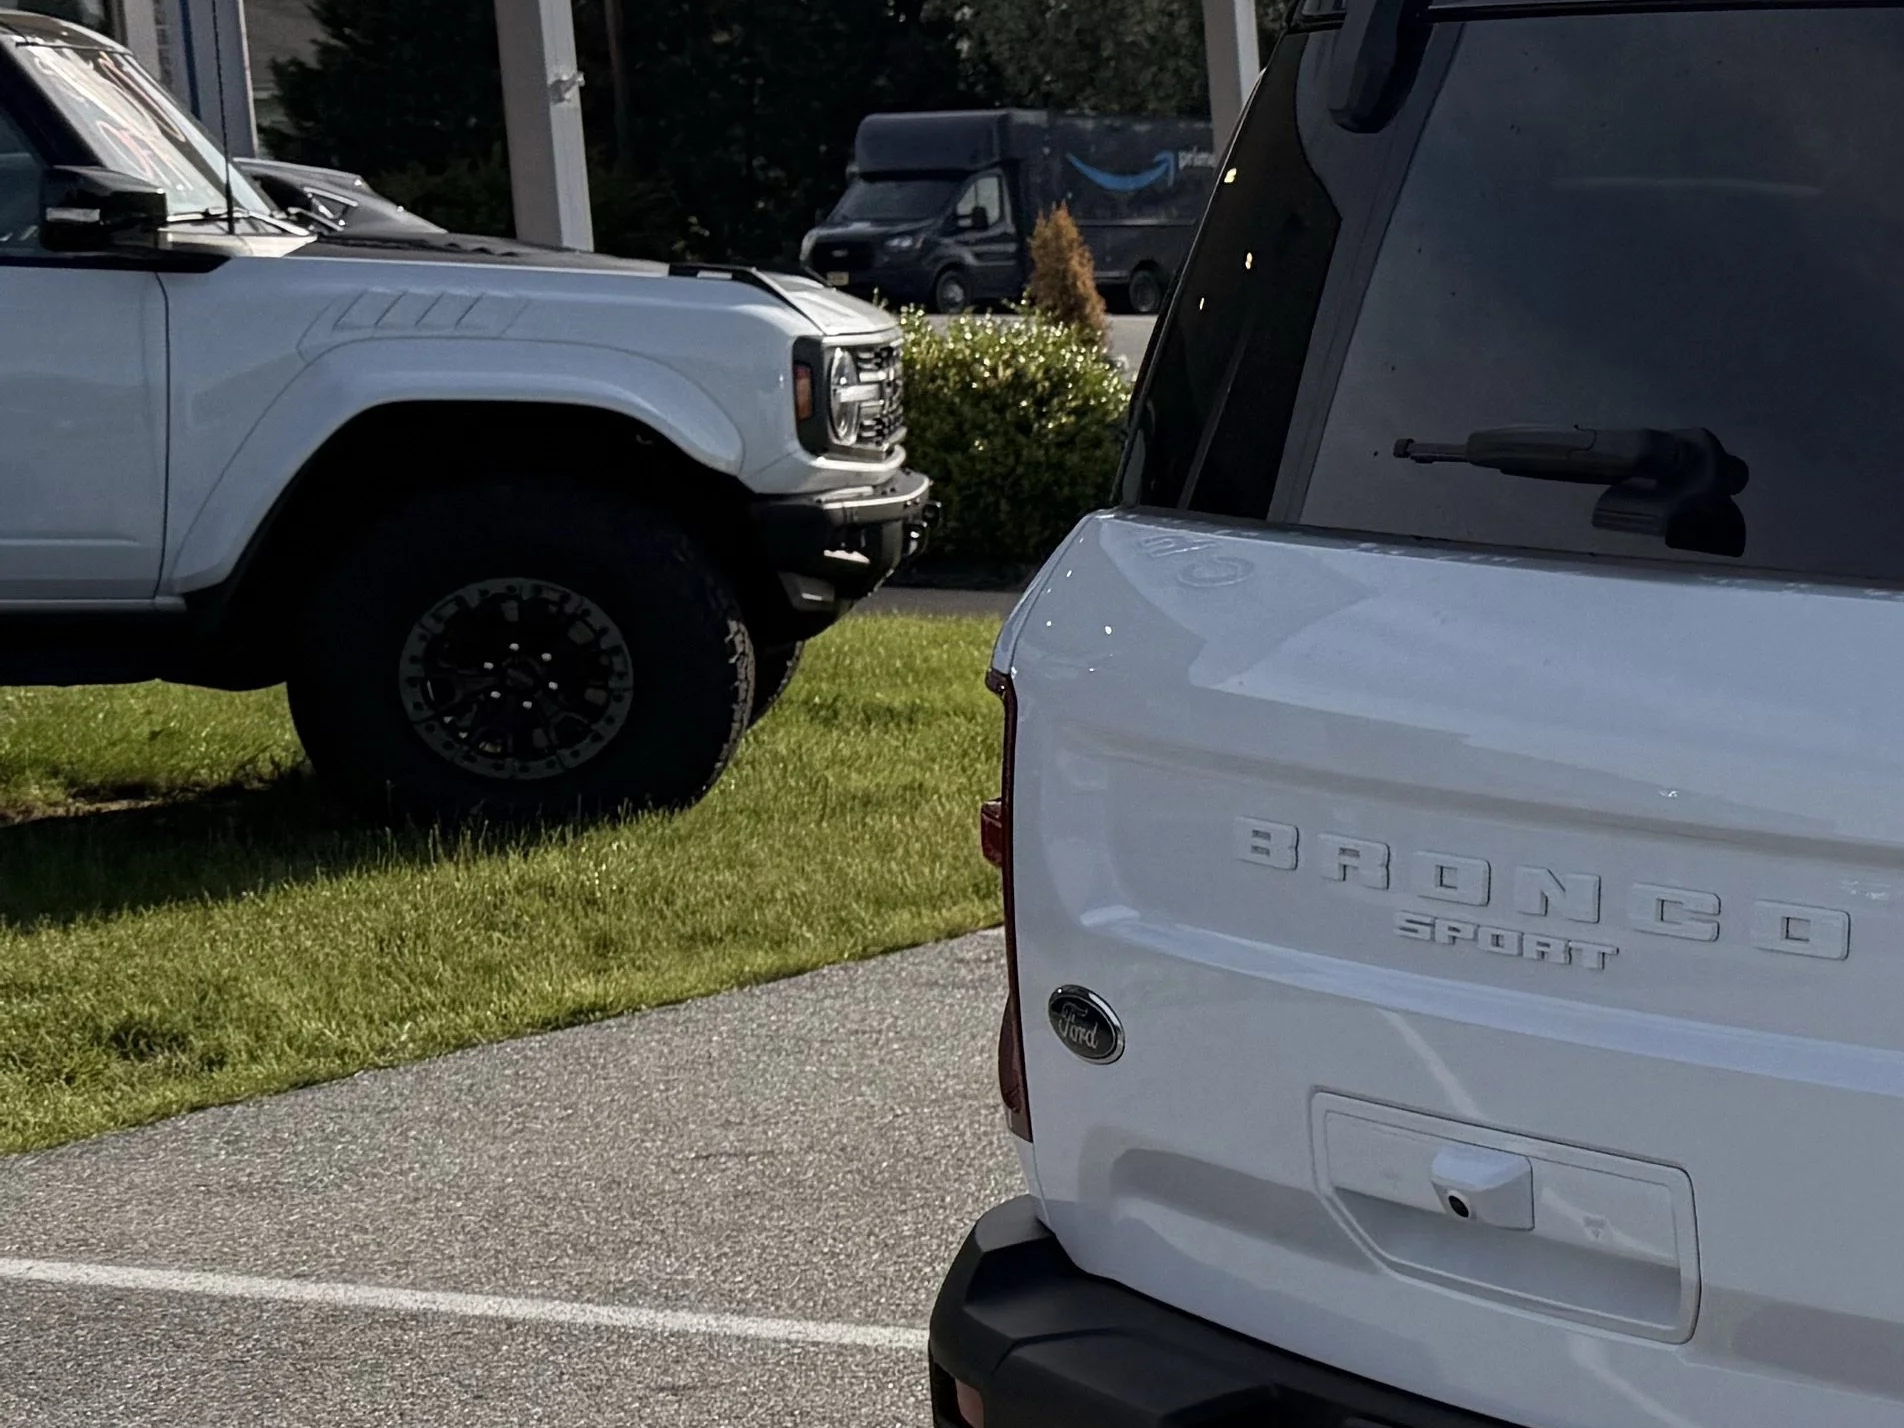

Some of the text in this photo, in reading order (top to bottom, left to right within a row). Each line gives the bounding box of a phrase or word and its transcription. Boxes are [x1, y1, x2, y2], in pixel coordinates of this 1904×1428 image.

[1232, 816, 1851, 961] BRONCO
[1393, 909, 1620, 971] SPORT
[1057, 1001, 1099, 1049] Ford
